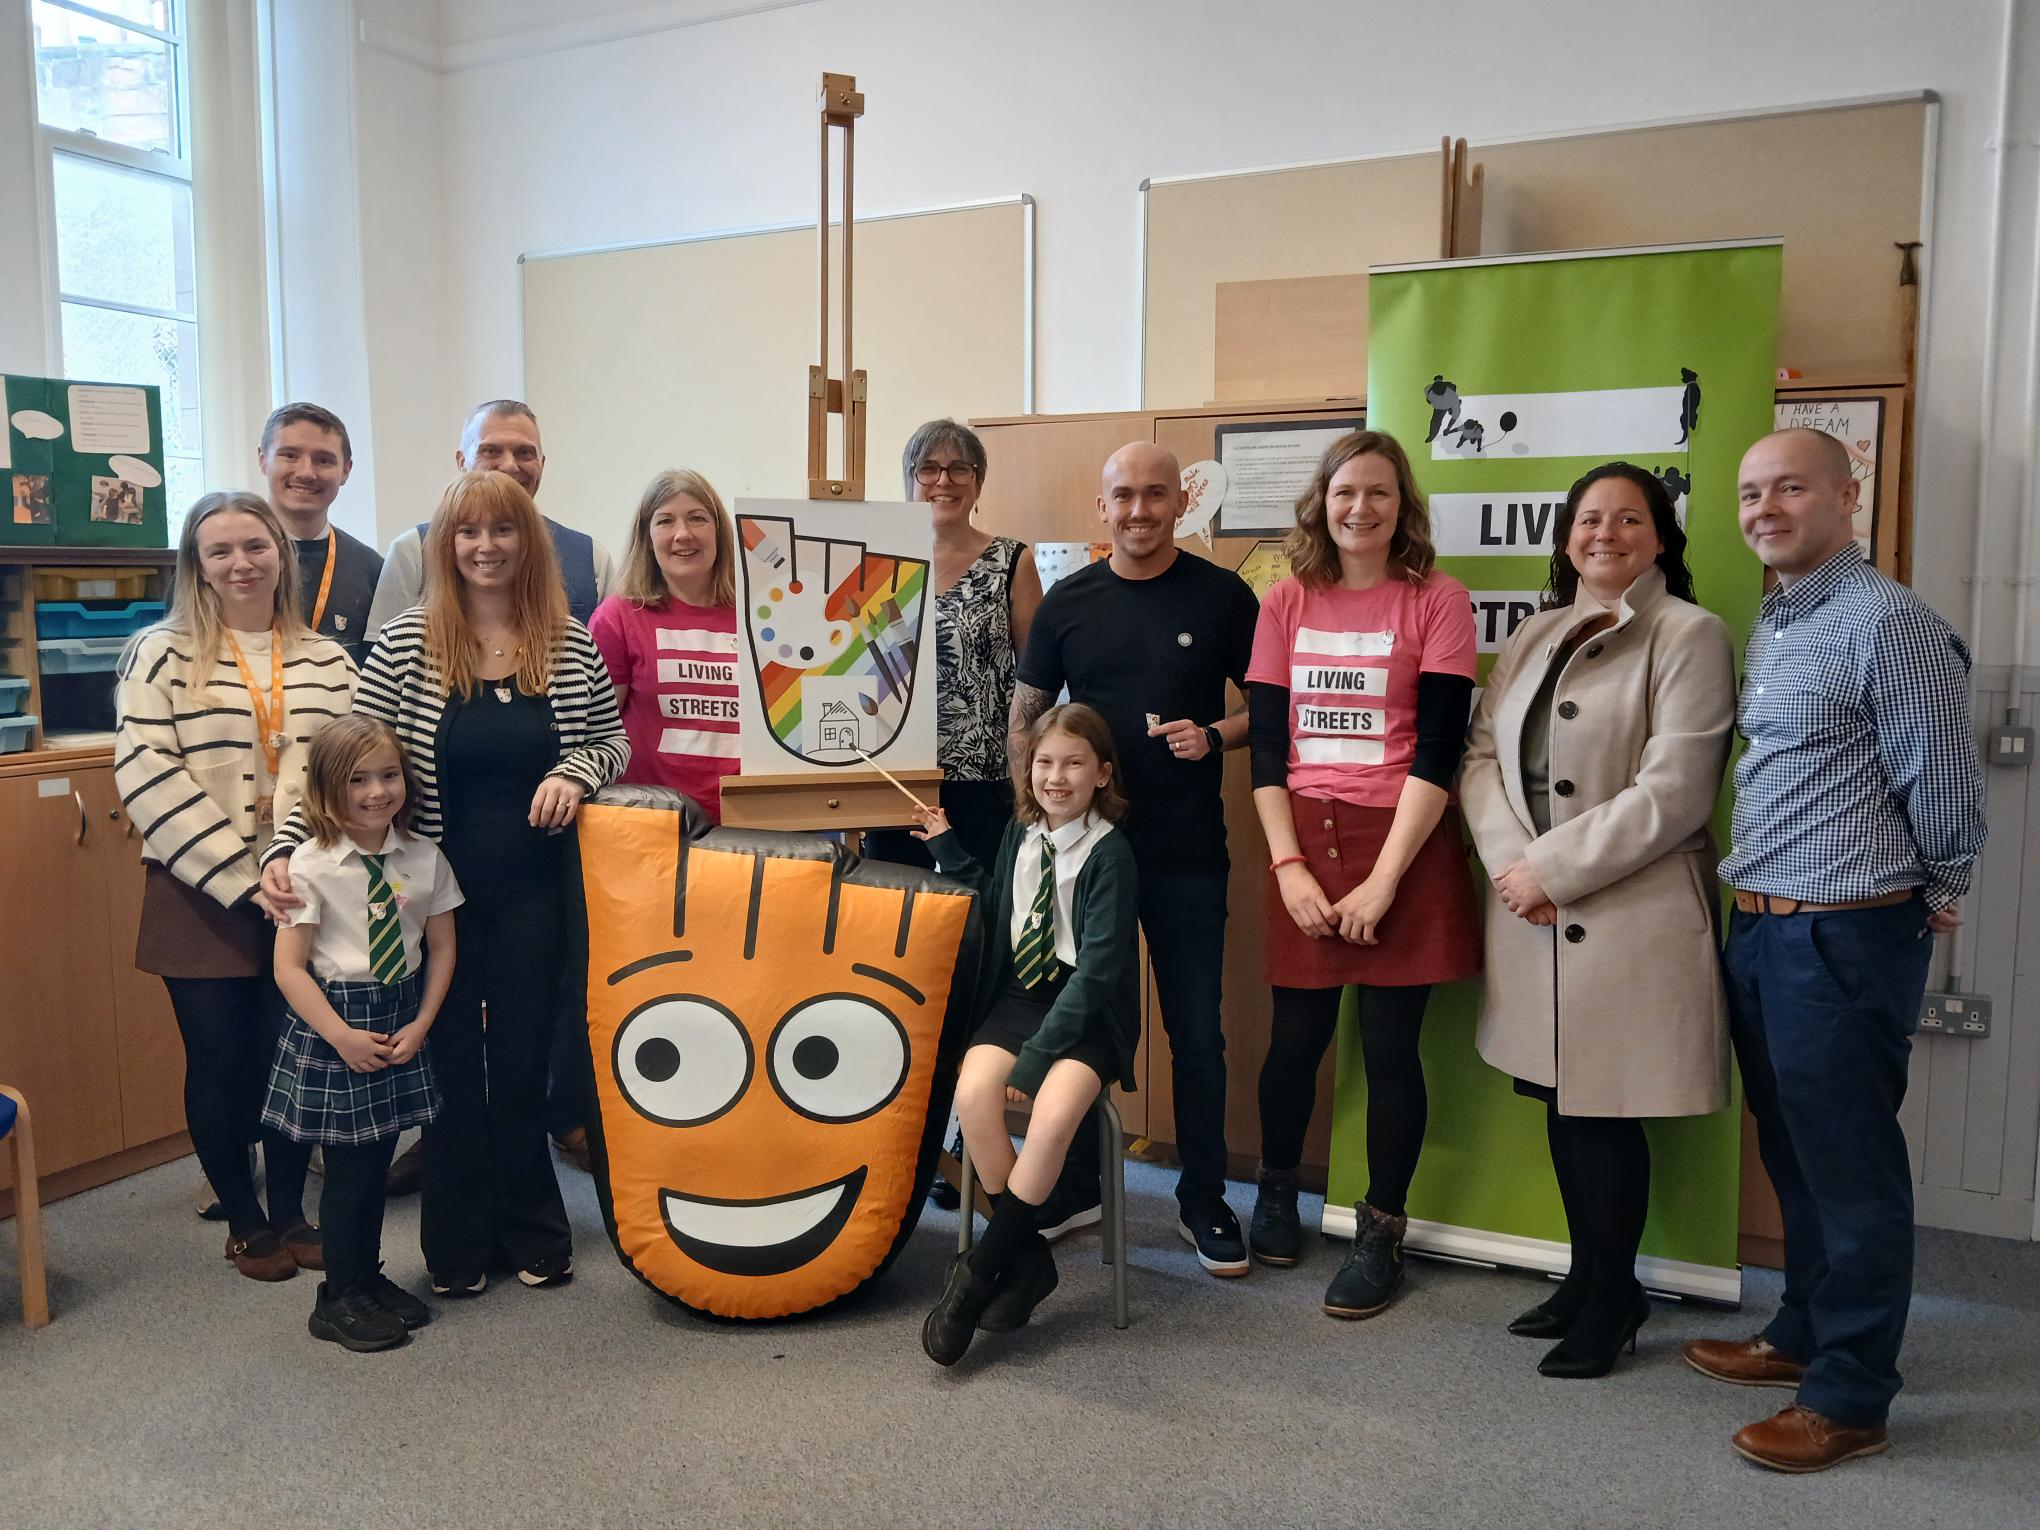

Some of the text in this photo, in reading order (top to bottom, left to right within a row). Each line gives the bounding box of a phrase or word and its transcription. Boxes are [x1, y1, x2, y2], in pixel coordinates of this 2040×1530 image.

[1793, 403, 1823, 415] HAVE
[1830, 403, 1839, 413] A
[678, 663, 732, 681] LIVING
[1307, 671, 1365, 690] LIVING
[669, 698, 739, 718] STREETS
[1303, 709, 1372, 730] STREETS
